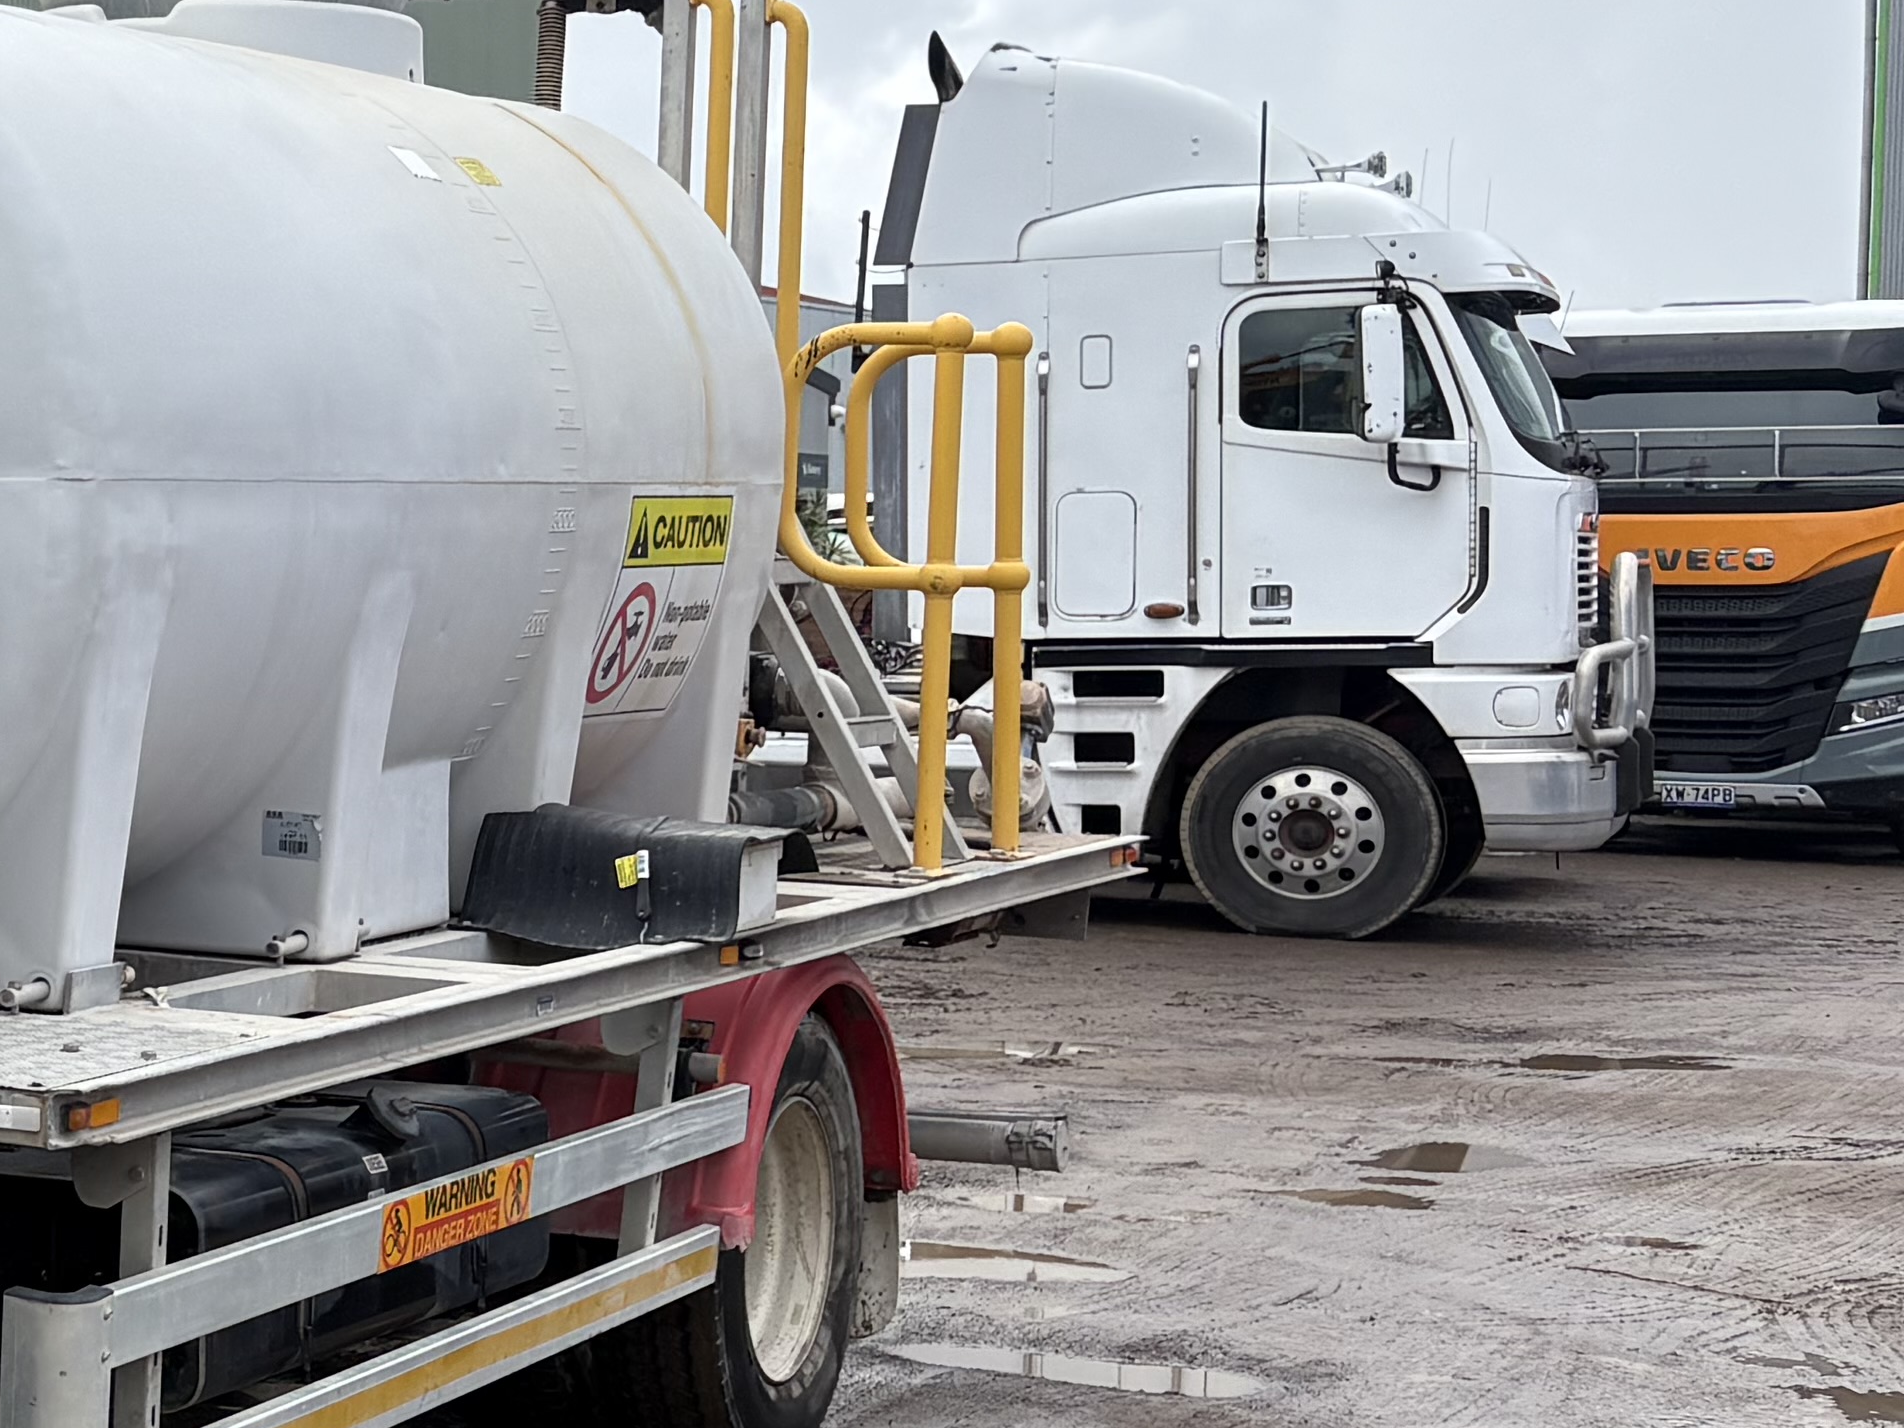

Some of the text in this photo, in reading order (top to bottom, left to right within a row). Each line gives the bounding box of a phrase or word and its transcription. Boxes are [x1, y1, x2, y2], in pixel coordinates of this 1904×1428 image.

[653, 514, 728, 549] CAUTION
[424, 1168, 496, 1220] WARNING
[415, 1207, 497, 1256] DANGER ZONE
